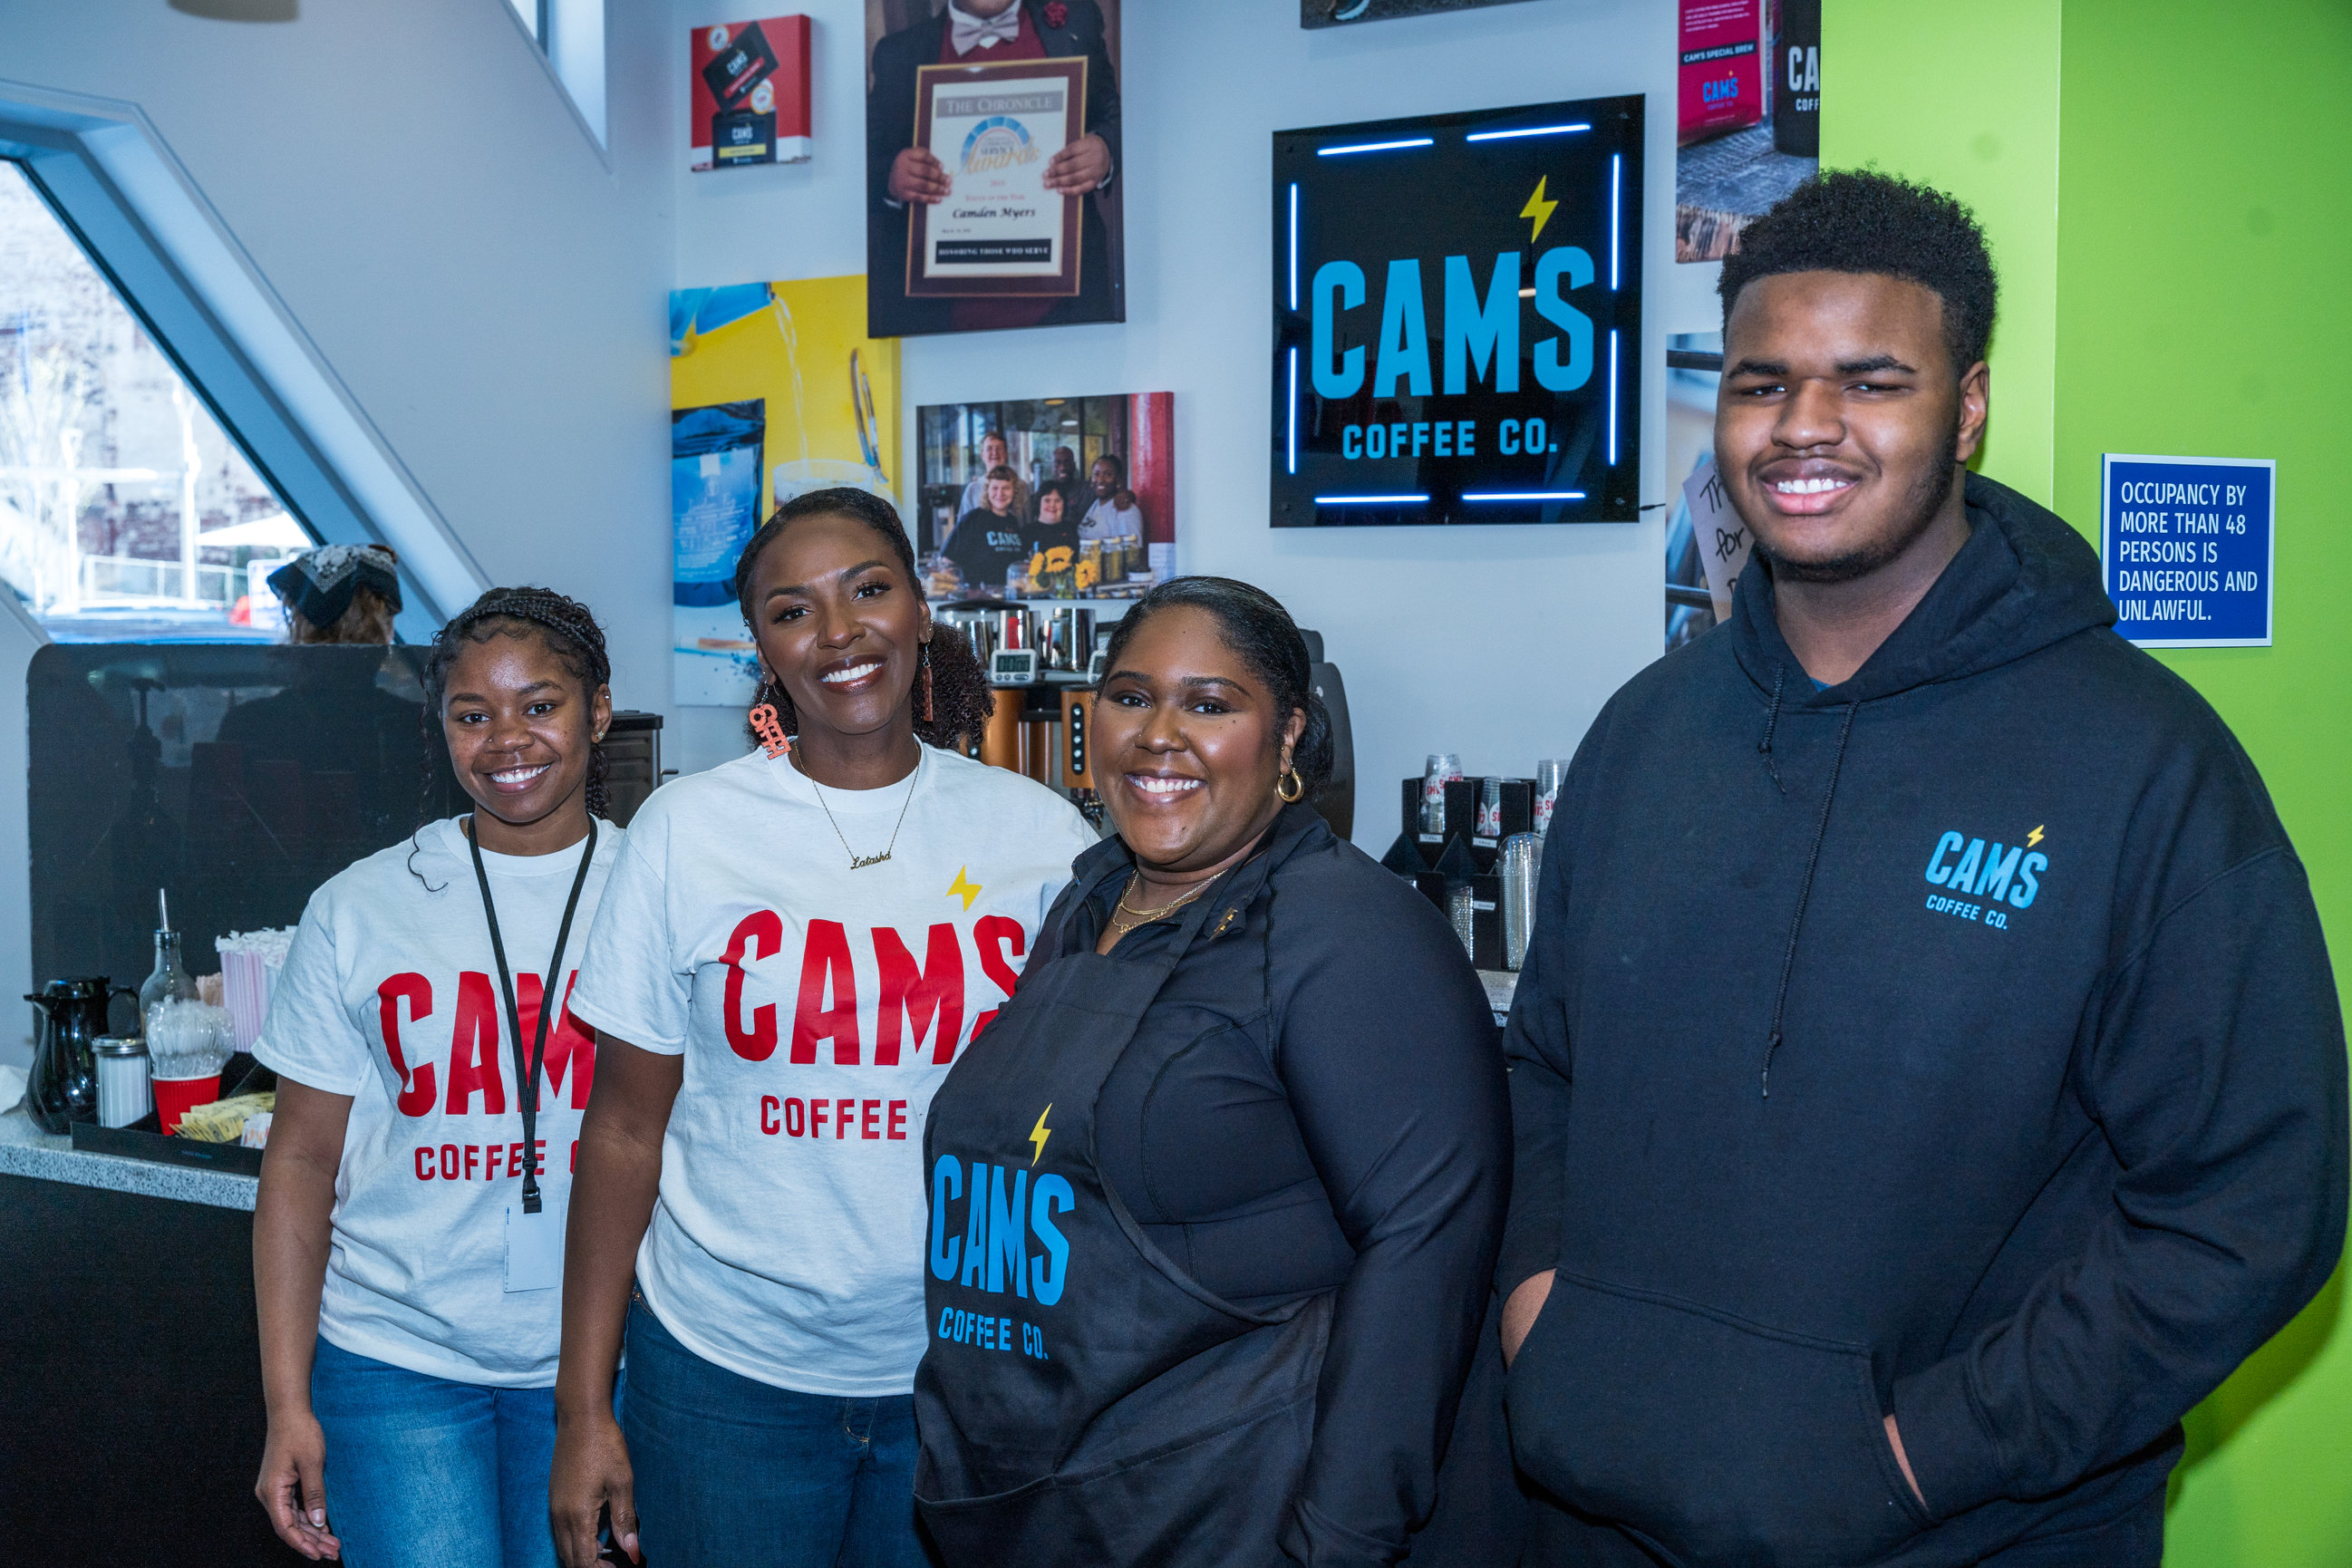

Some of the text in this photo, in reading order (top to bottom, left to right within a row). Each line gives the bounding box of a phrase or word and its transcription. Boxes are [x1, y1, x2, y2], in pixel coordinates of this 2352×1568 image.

[1683, 44, 1755, 63] CAM'S SPECIAL BREW
[947, 96, 1052, 113] THE CHRONICLE
[953, 206, 1036, 220] Camden Myers
[1025, 247, 1049, 255] SERVE
[1342, 418, 1557, 460] COFFEE CO.
[2121, 481, 2247, 506] OCCUPANCY BY
[2120, 511, 2246, 535] MORE THAN 48
[2119, 540, 2218, 563] PERSONS IS
[2119, 570, 2258, 592] DANGEROUS AND
[2118, 599, 2212, 621] UNLAWFUL.
[1925, 894, 2008, 930] COFFEE CO.
[760, 1095, 907, 1140] COFFEE
[414, 1139, 547, 1181] COFFEE
[938, 1306, 1049, 1360] COFFEE CO.
